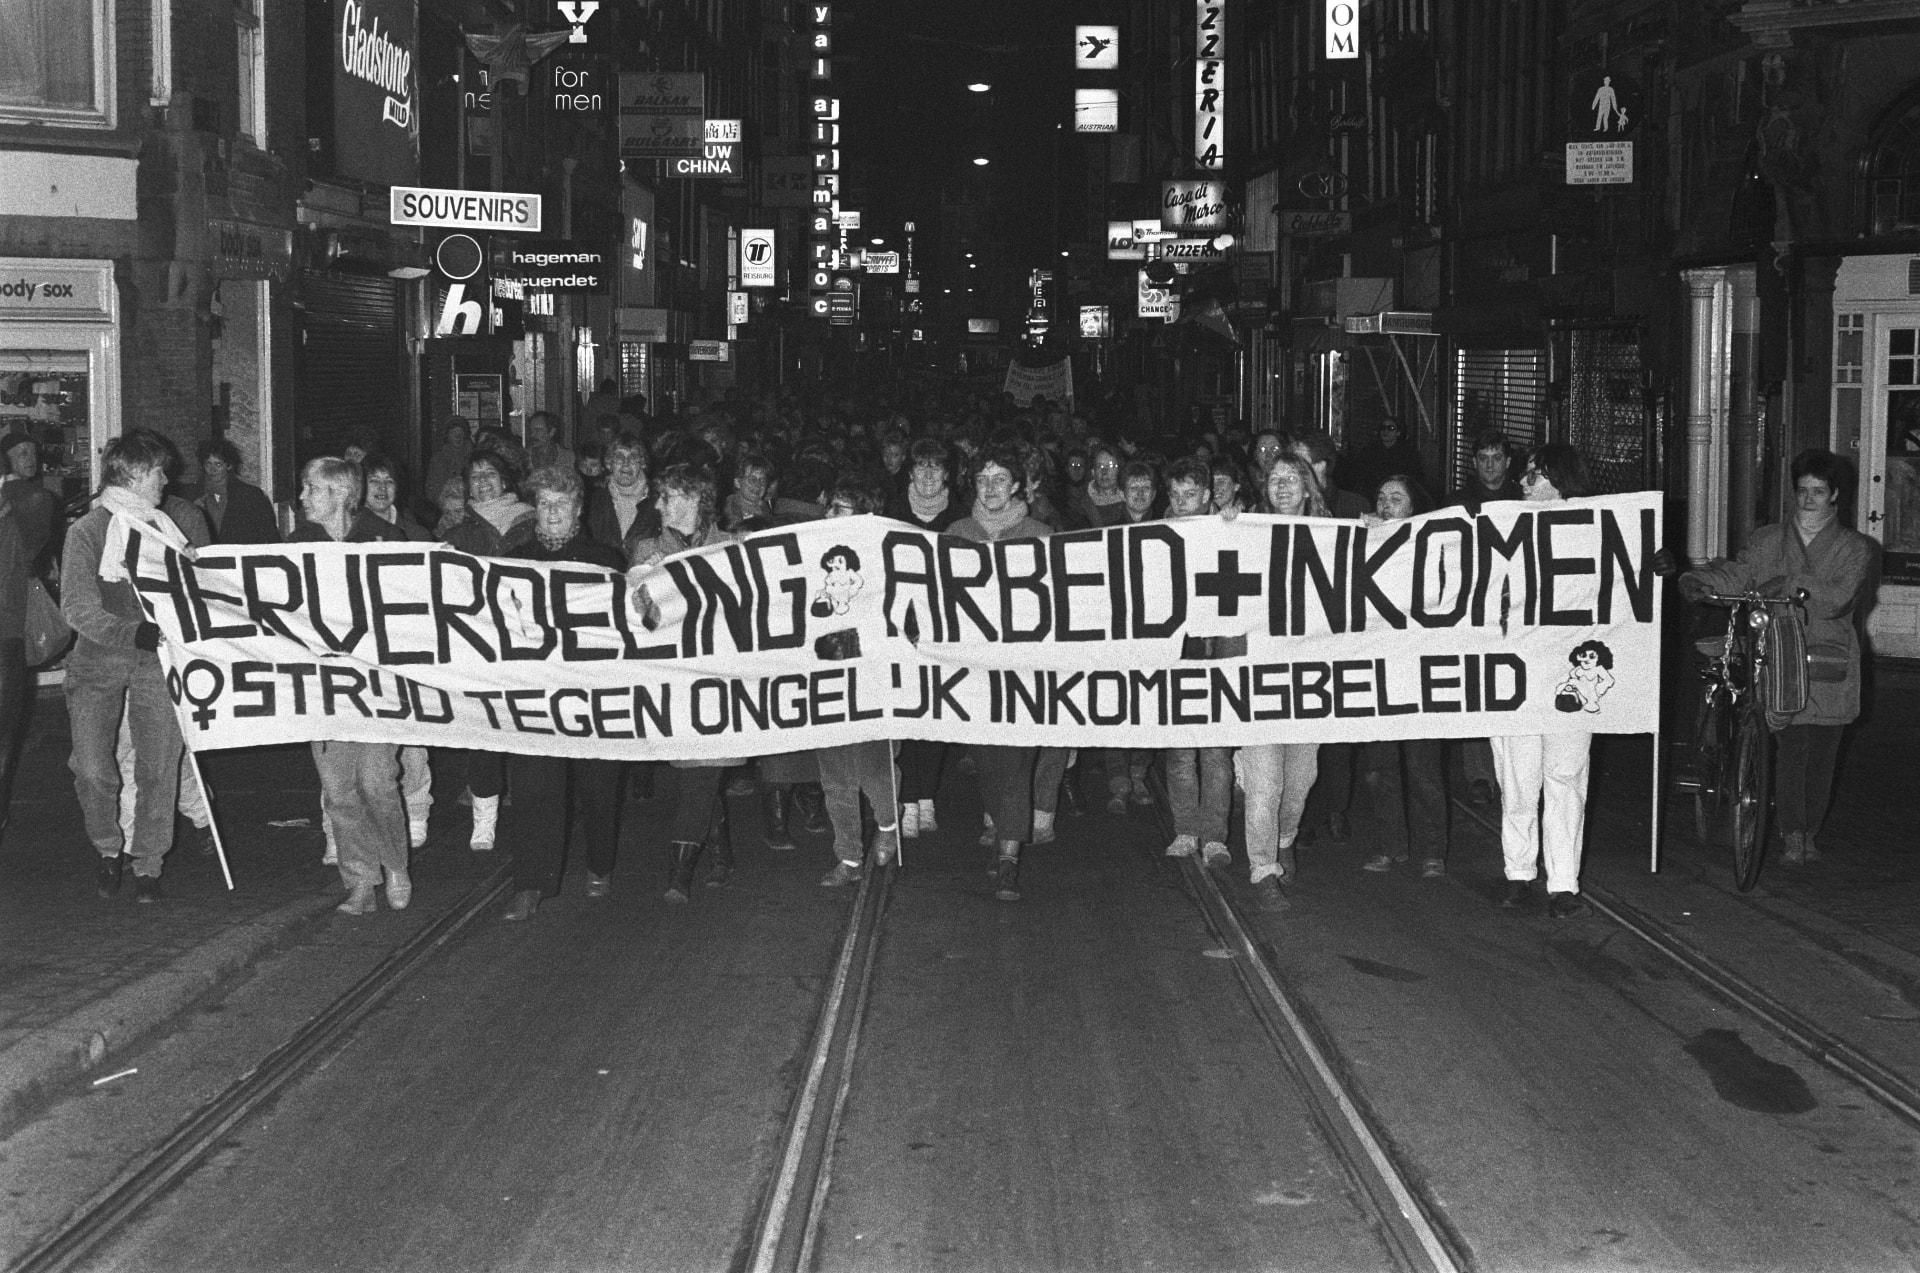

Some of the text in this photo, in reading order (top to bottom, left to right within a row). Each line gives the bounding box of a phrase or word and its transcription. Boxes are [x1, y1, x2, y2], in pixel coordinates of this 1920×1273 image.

[342, 0, 409, 97] Gladstone
[555, 66, 589, 87] for
[1200, 0, 1220, 167] ZZERIA
[555, 94, 601, 111] men
[1078, 123, 1116, 131] AUSTRIAN
[676, 159, 732, 174] CHINA
[1164, 182, 1208, 209] Casa di
[402, 193, 529, 224] SOUVENIRS
[1182, 203, 1224, 223] Marco
[512, 250, 601, 267] hageman
[743, 272, 773, 280] REISBURO
[0, 278, 73, 302] ody sox
[124, 527, 807, 665] HERVERDELING
[881, 524, 1188, 644] ARBEID
[1268, 508, 1655, 637] INKOMEN
[231, 652, 1527, 739] STRIJD TEGEN ONGELIJK INKOMENSBELEID
